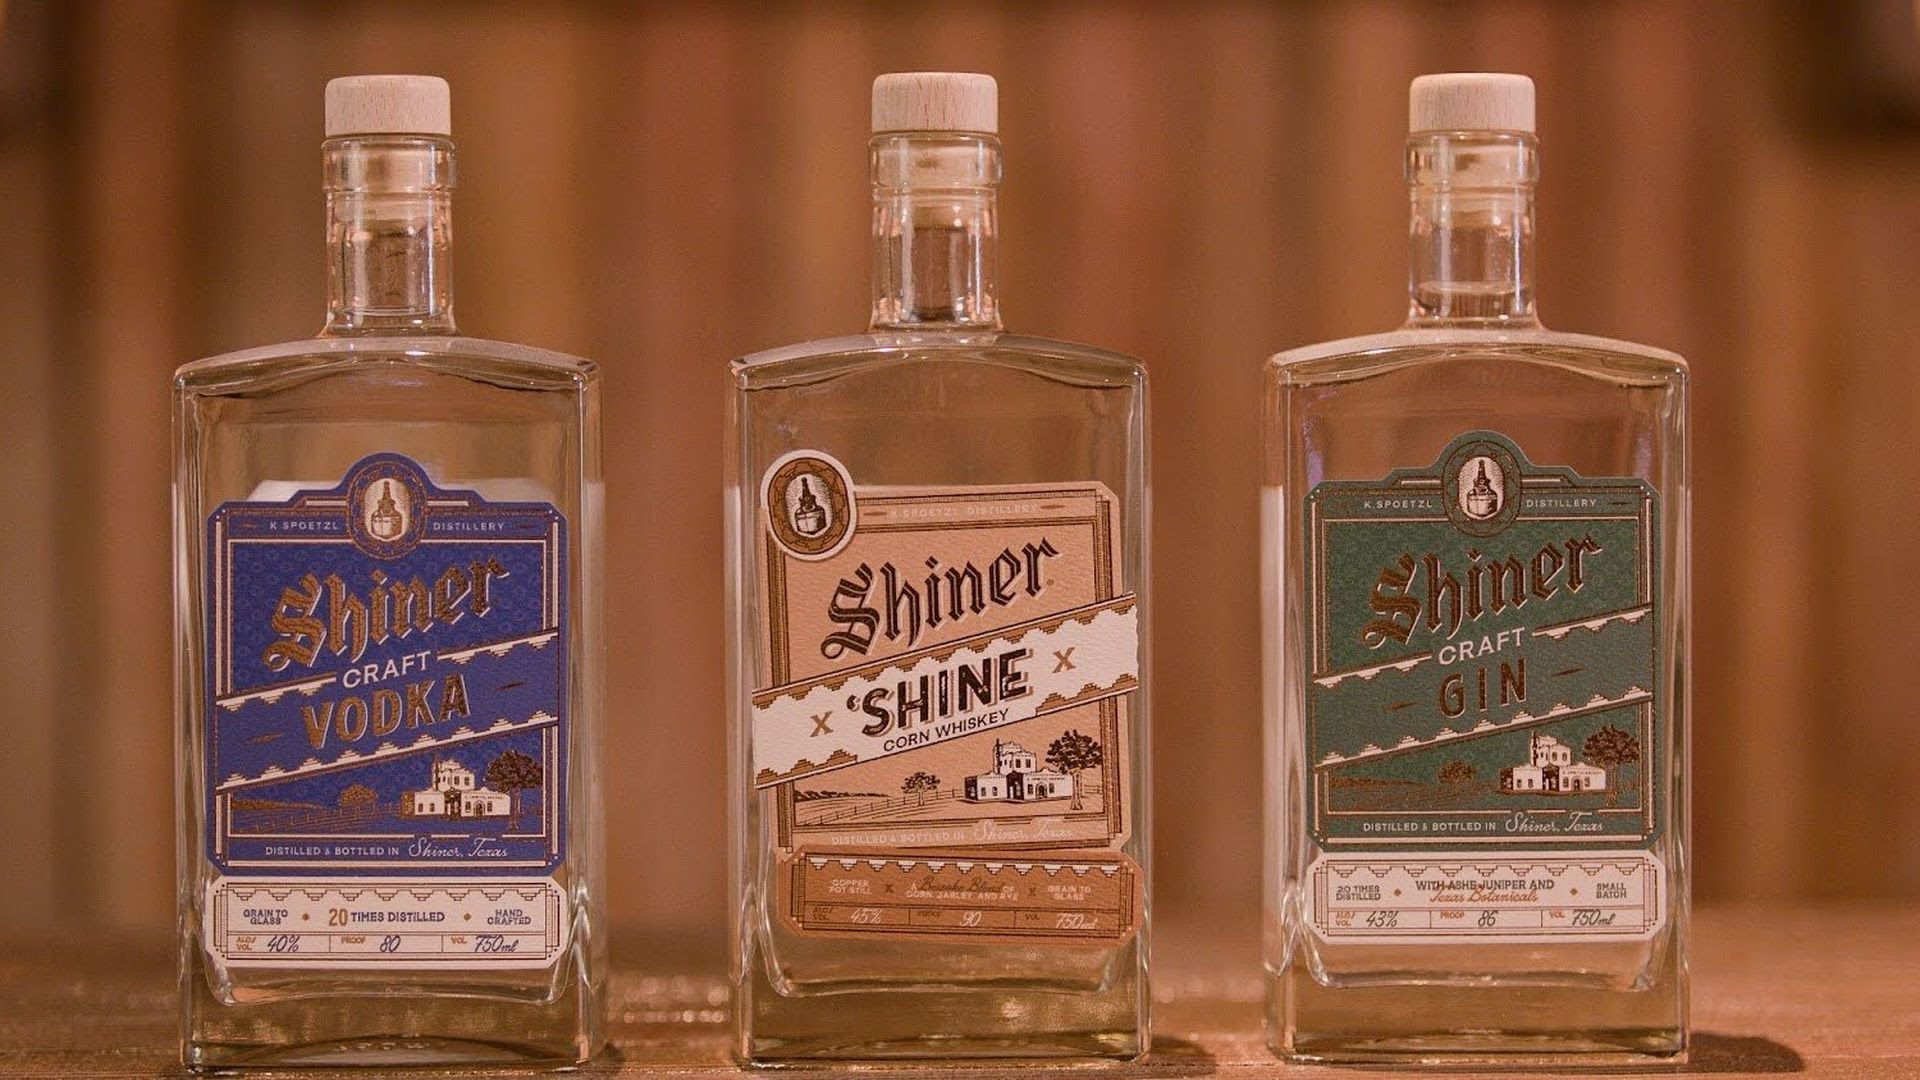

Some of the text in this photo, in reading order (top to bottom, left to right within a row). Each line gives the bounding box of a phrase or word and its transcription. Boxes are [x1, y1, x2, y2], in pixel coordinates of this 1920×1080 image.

[967, 504, 1037, 515] DISTILLERY
[1526, 499, 1598, 508] DISTILLERY
[282, 521, 339, 530] SPOETZL
[433, 522, 504, 531] DISTILLERY
[820, 537, 1060, 661] Shiner
[1362, 532, 1603, 650] Shiner
[261, 554, 510, 672] Shiner
[1438, 626, 1525, 666] CRAFT
[342, 651, 431, 688] CRAFT
[1439, 657, 1528, 718] GIN
[302, 673, 472, 750] VODKA
[883, 708, 1010, 753] CORN WHISKEY
[1363, 822, 1419, 832] DISTILLED
[1432, 822, 1482, 832] BOTTLED
[1484, 822, 1496, 831] IN
[1562, 812, 1604, 832] Texas
[832, 835, 887, 846] DISTILLED
[900, 832, 949, 843] BOTTLED
[953, 832, 965, 841] IN
[265, 846, 322, 856] DISTILLED
[334, 846, 385, 856] BOTTLED
[388, 846, 399, 856] IN
[467, 837, 509, 858] Texas
[832, 879, 869, 888] COPPER
[848, 887, 872, 895] STILL
[1047, 885, 1076, 893] GRAIN
[1338, 885, 1380, 893] 20 TIMES
[1415, 880, 1554, 891] WITH ASHE JUNIPER AND
[1597, 883, 1626, 891] SMALL
[1053, 893, 1084, 901] GLASS
[1336, 892, 1381, 901] DISTILLED
[1467, 883, 1539, 903] Botanicals
[1596, 890, 1627, 899] BATCH
[243, 909, 288, 918] GRAIN TO
[250, 917, 281, 925] GLASS
[329, 908, 445, 927] 20 TIMES DISTILLED
[487, 917, 531, 925] CRAFTED
[495, 909, 523, 918] HAND
[850, 907, 883, 924] 45%
[959, 911, 982, 927] 90
[1366, 910, 1399, 928] 43%
[1440, 911, 1465, 919] PROOF
[1478, 910, 1499, 927] 86
[1572, 909, 1616, 926] 750ml
[267, 934, 301, 953] 40%
[379, 934, 401, 953] 80
[474, 934, 519, 953] 750ml
